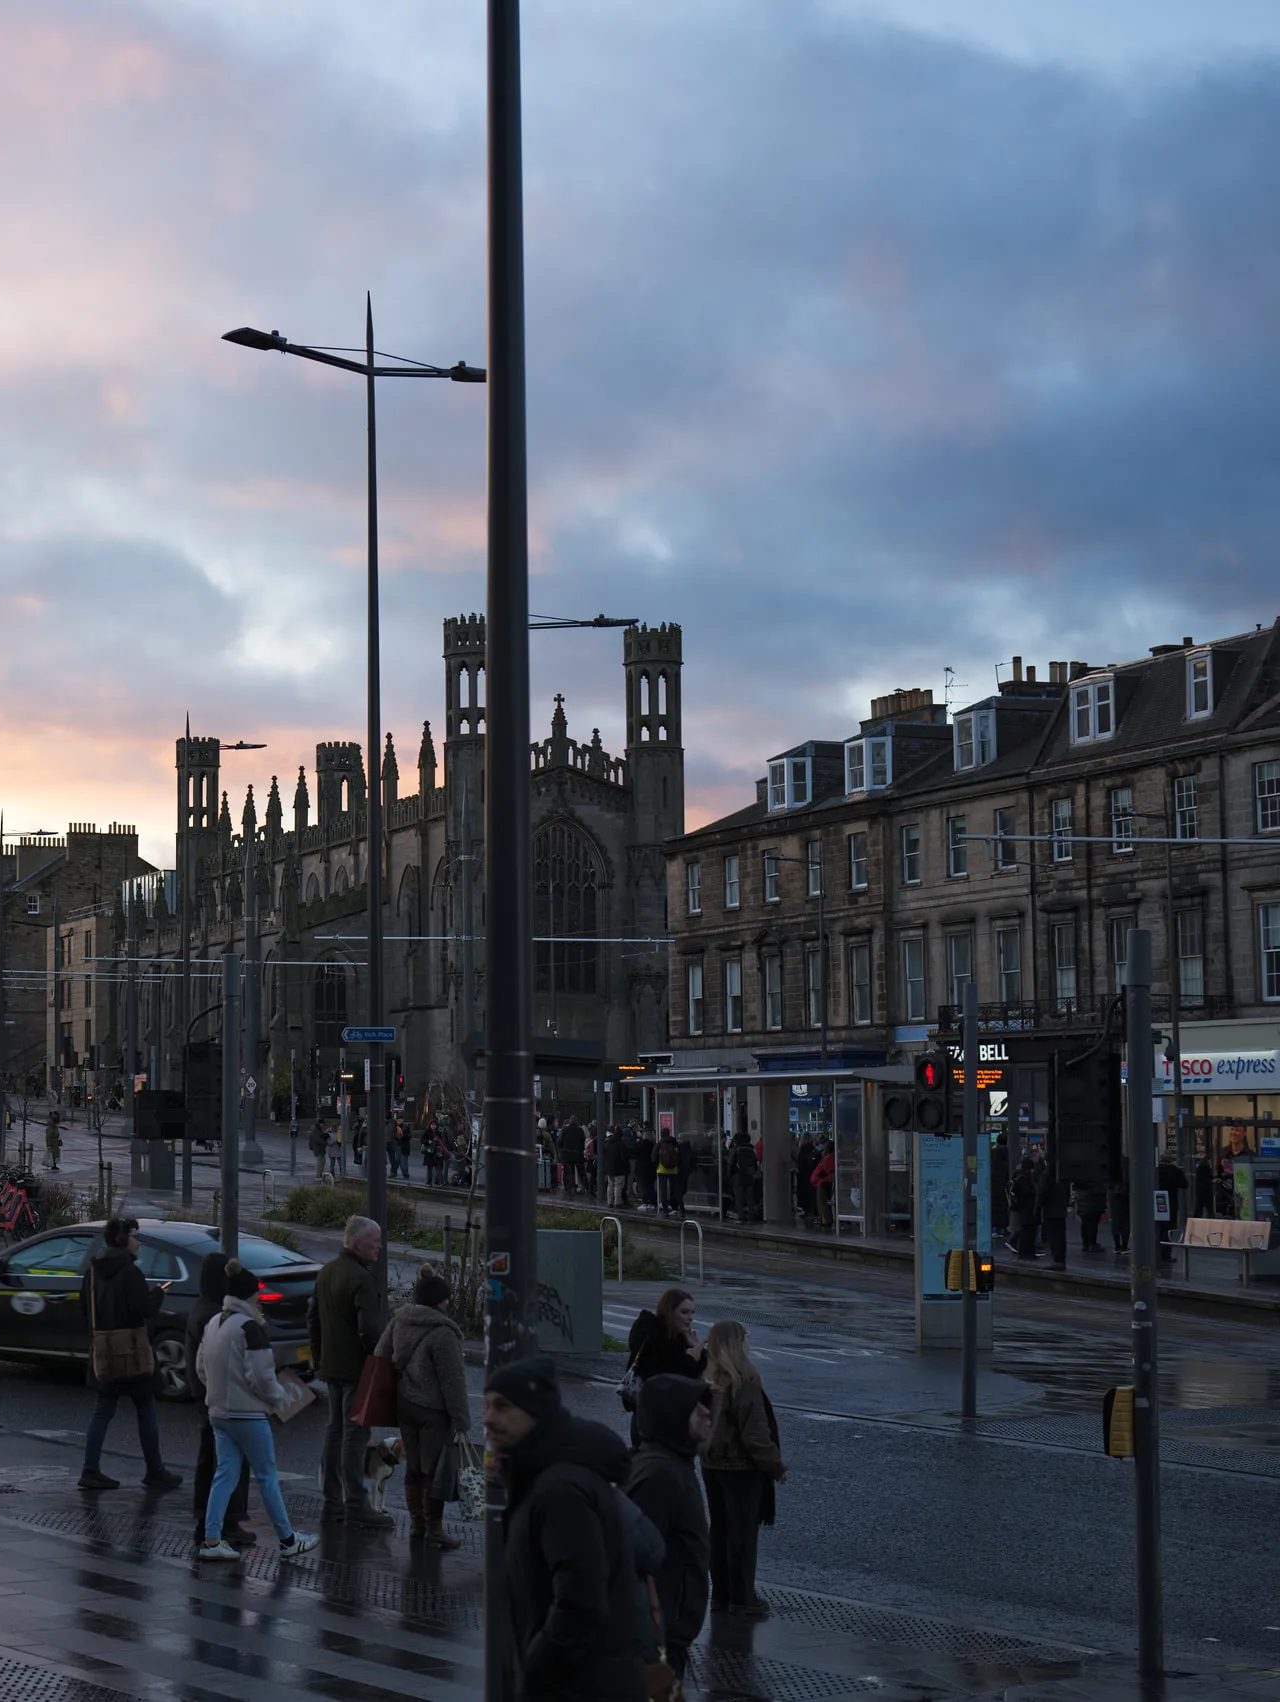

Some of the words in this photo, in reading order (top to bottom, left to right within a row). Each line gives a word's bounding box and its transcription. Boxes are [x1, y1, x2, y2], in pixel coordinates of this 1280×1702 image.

[378, 1031, 393, 1039] Place
[978, 1043, 1009, 1062] BELL
[1162, 1058, 1212, 1076] TSCO
[1216, 1056, 1276, 1080] express
